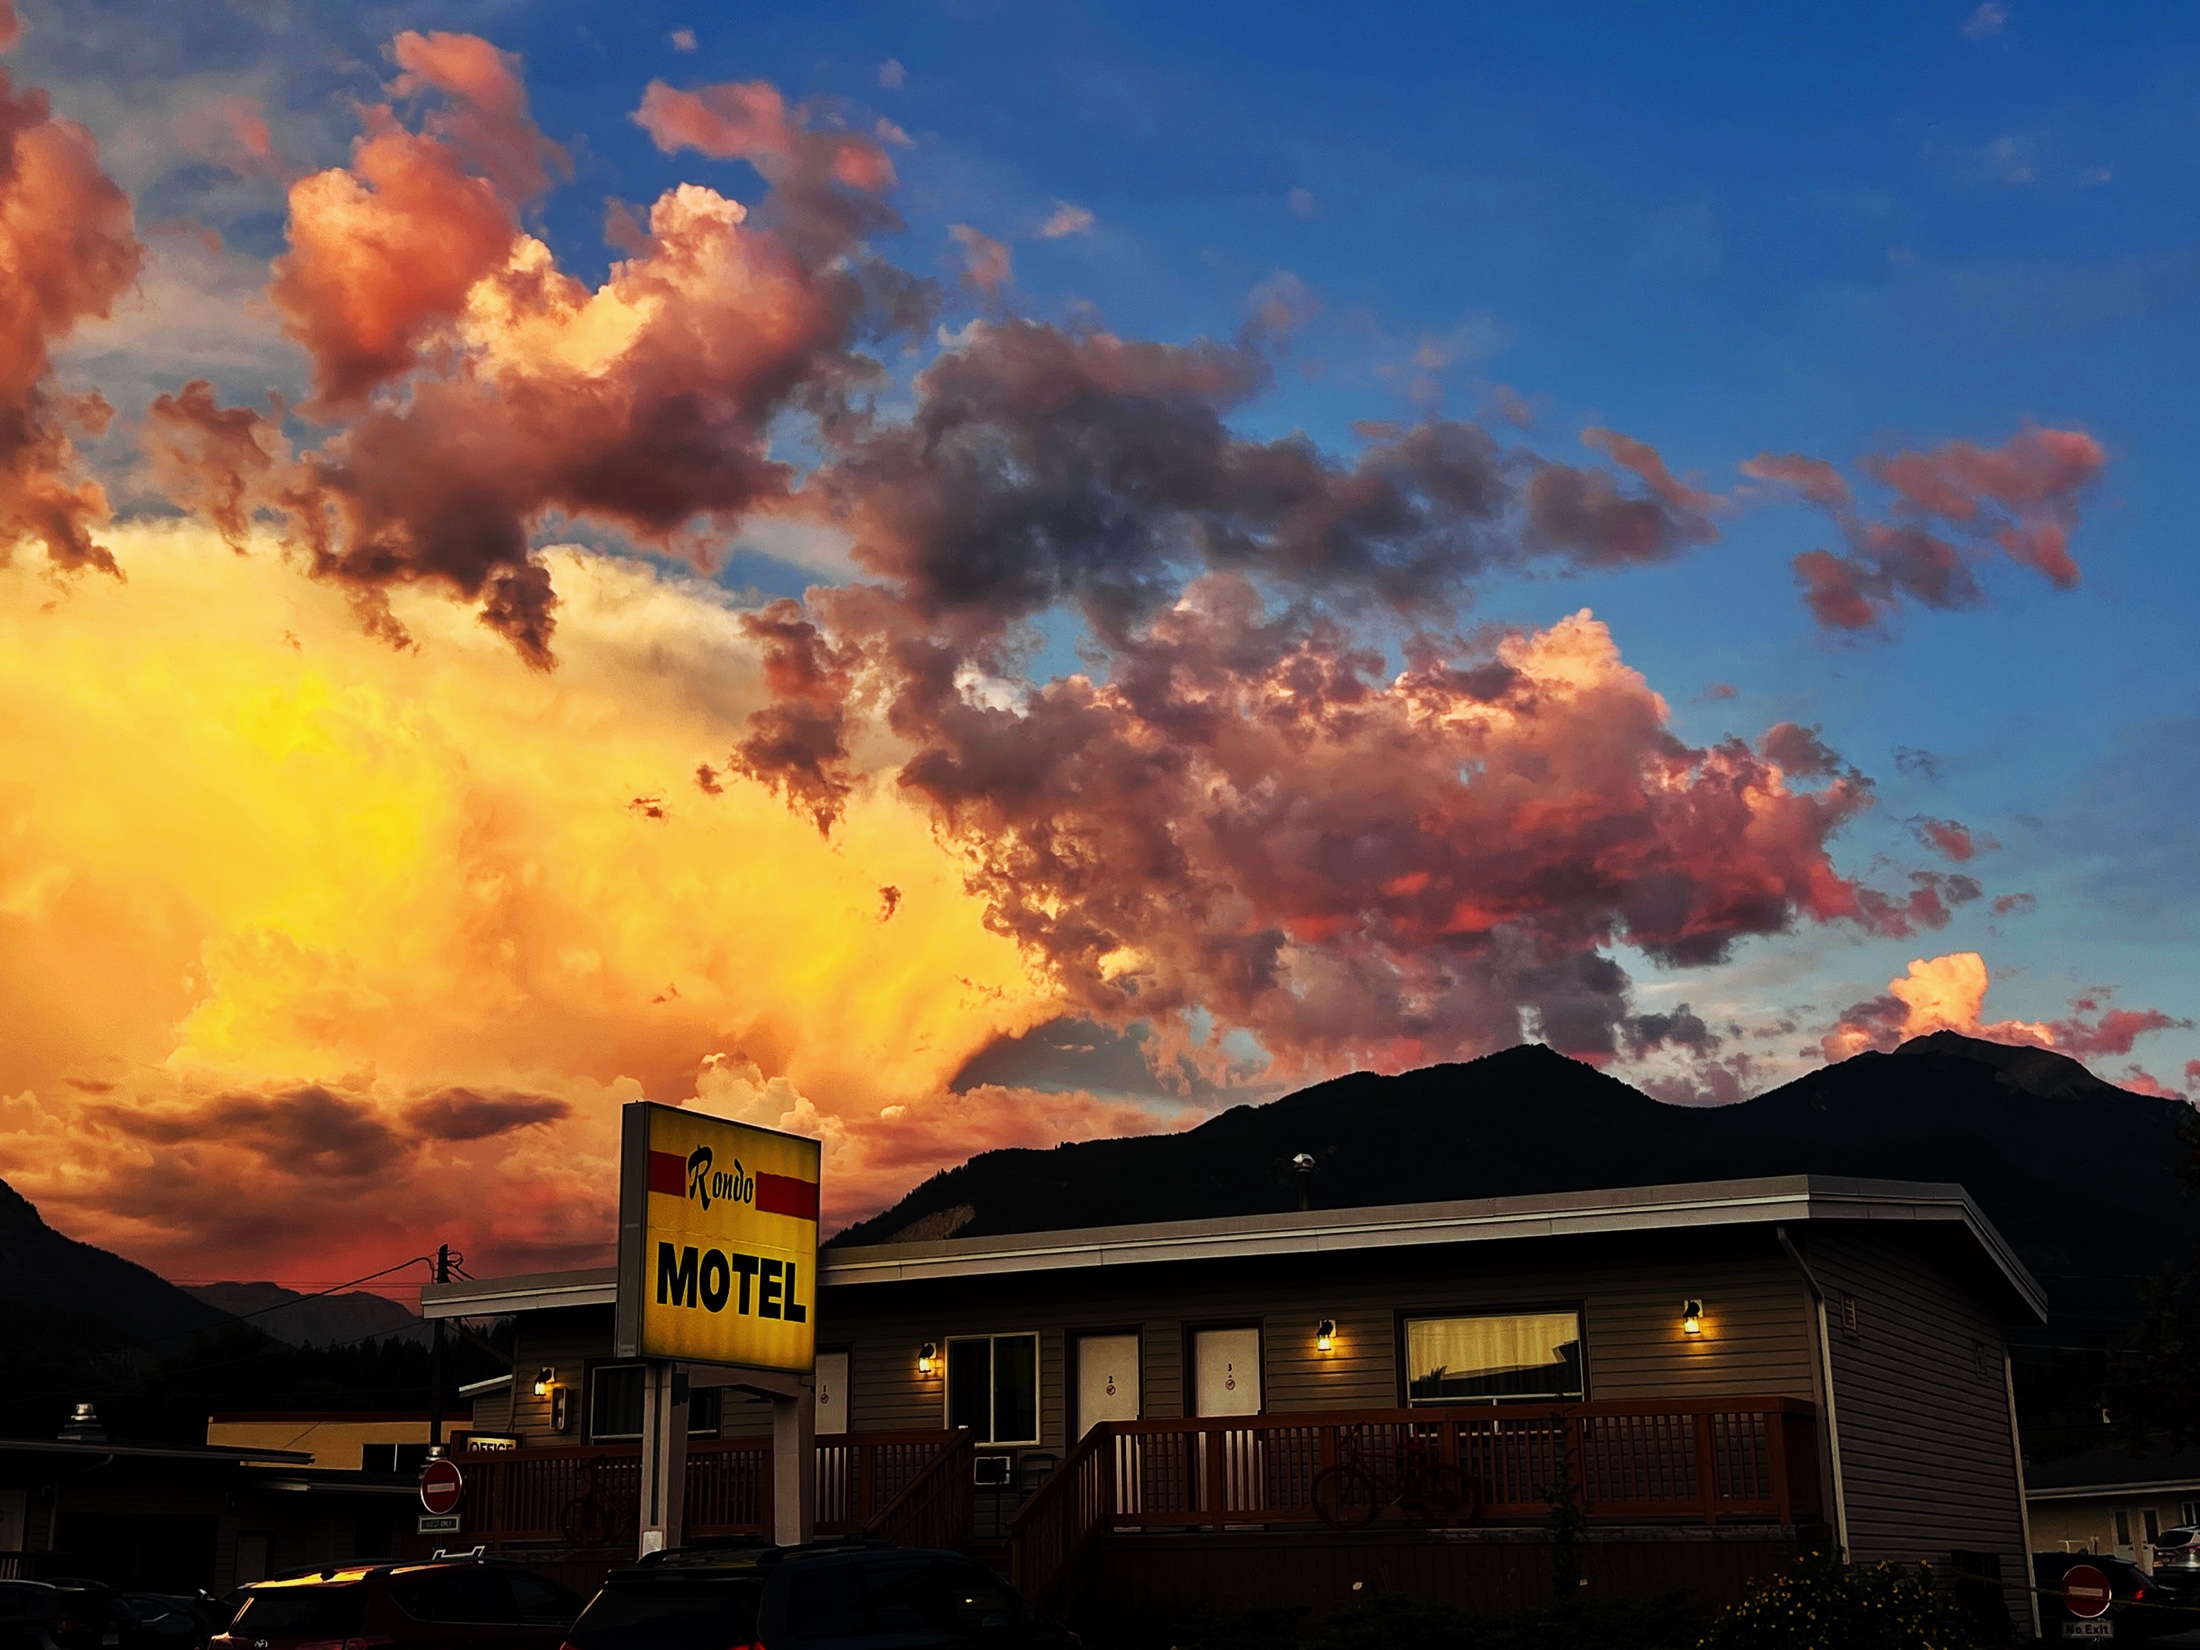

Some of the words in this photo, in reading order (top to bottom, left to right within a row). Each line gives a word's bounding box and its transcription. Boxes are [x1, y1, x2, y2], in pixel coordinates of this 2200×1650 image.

[688, 1144, 754, 1212] Rondo
[657, 1241, 806, 1323] MOTEL
[1108, 1375, 1114, 1384] 2
[2066, 1625, 2082, 1634] No
[2085, 1624, 2109, 1634] Exit
